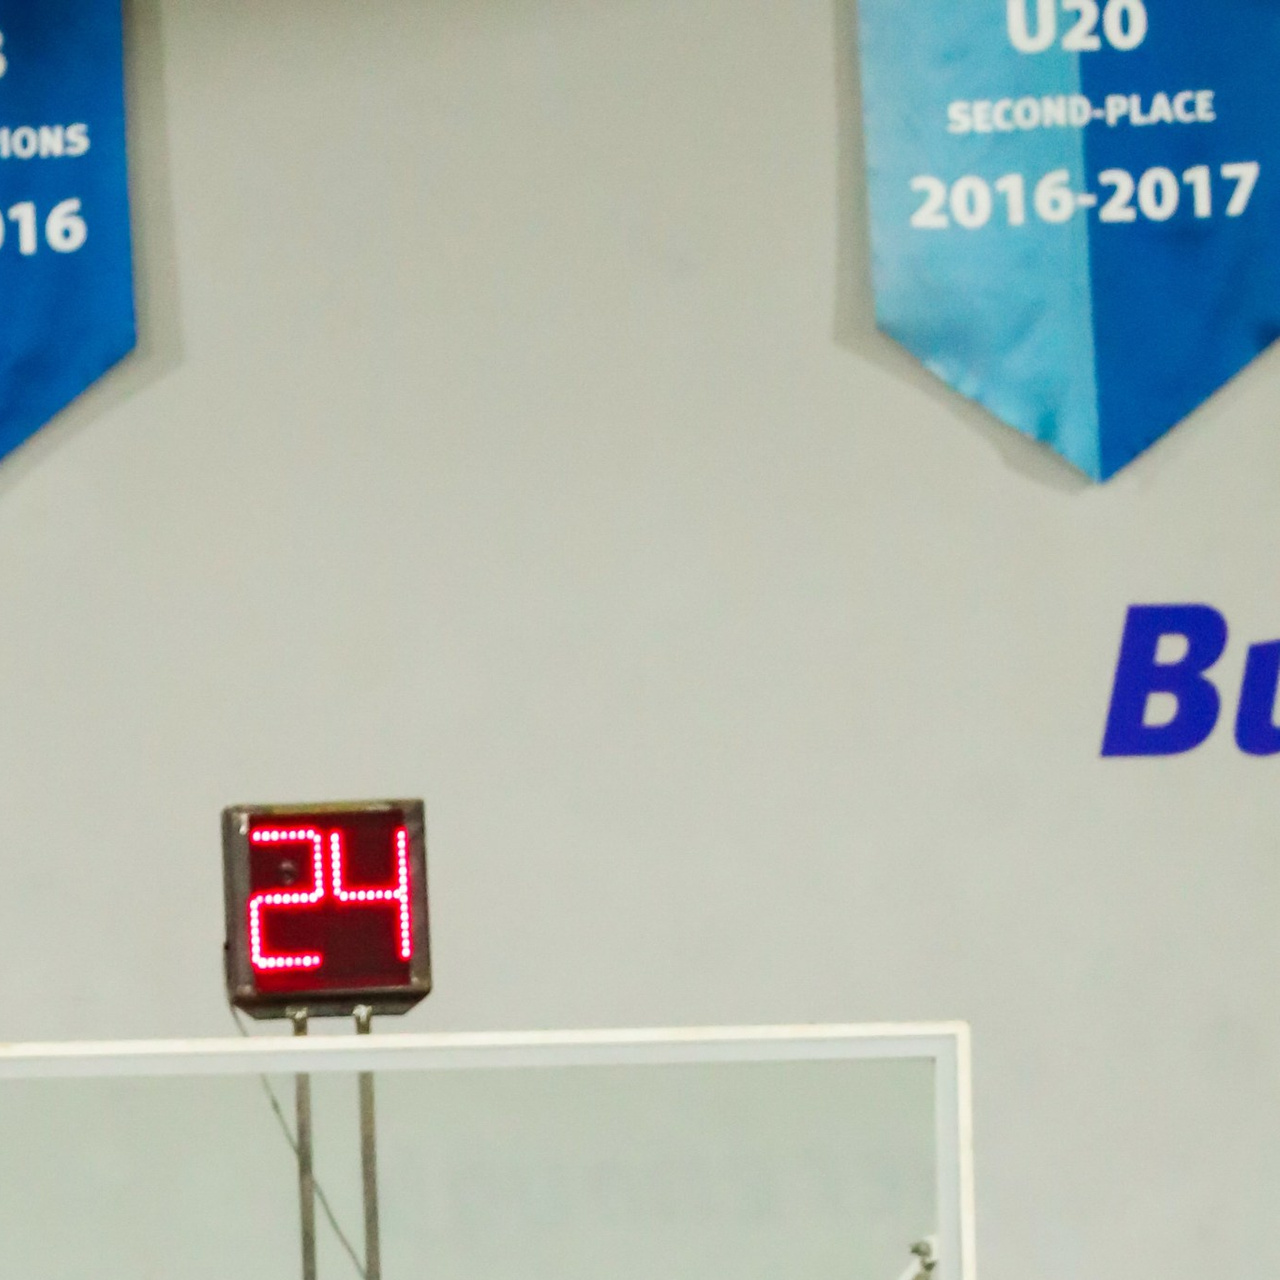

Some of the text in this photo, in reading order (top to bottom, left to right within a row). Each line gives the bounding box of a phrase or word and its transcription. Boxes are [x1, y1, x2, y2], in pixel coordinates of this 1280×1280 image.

[1006, 0, 1148, 54] U20
[947, 90, 1216, 134] SECOND-PLACE
[909, 161, 1261, 229] 2016-2017
[250, 825, 413, 972] 24
